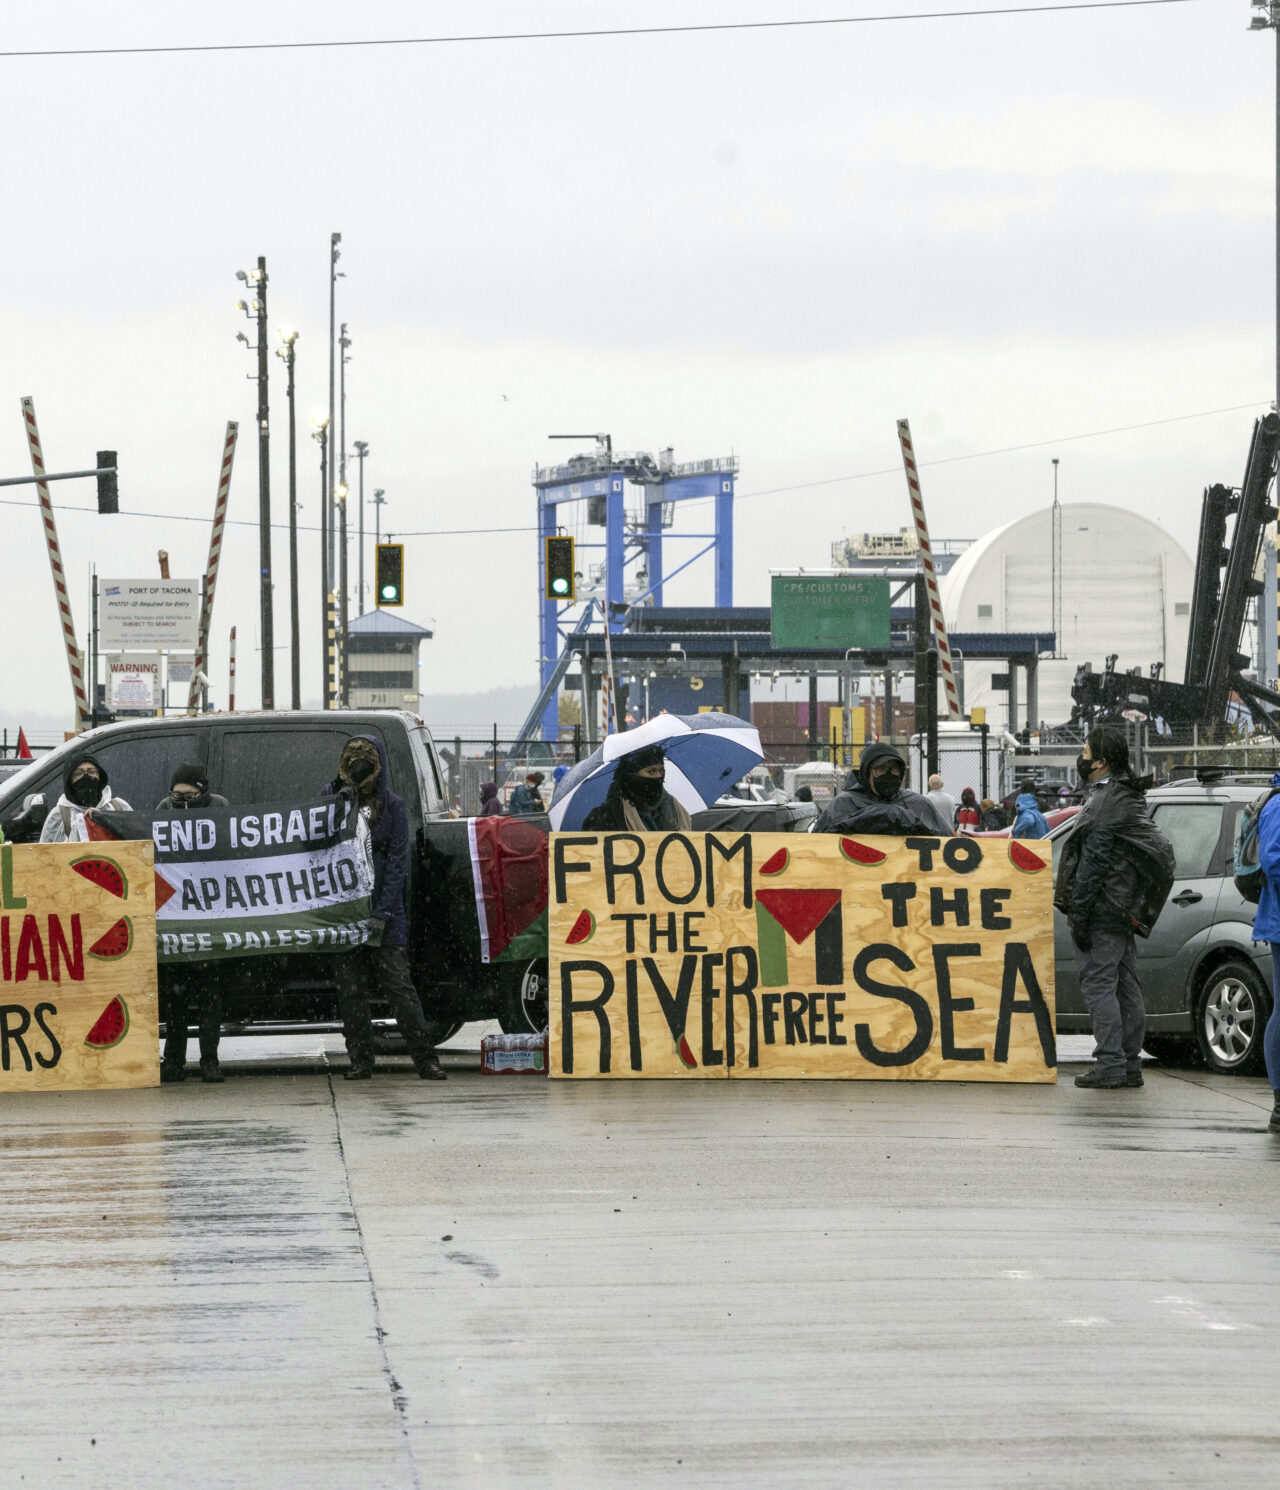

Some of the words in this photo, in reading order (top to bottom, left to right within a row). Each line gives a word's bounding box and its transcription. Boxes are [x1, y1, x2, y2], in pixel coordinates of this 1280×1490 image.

[110, 663, 158, 674] WARNING
[689, 676, 704, 691] 5
[152, 818, 217, 852] END
[905, 837, 983, 874] TO
[181, 857, 359, 912] APARTHEID
[554, 833, 753, 909] FROM
[881, 882, 1012, 930] THE
[156, 932, 213, 955] REE
[610, 912, 708, 953] THE
[560, 946, 759, 1074] RIVER
[761, 992, 847, 1046] FREE
[853, 942, 1057, 1068] SEA
